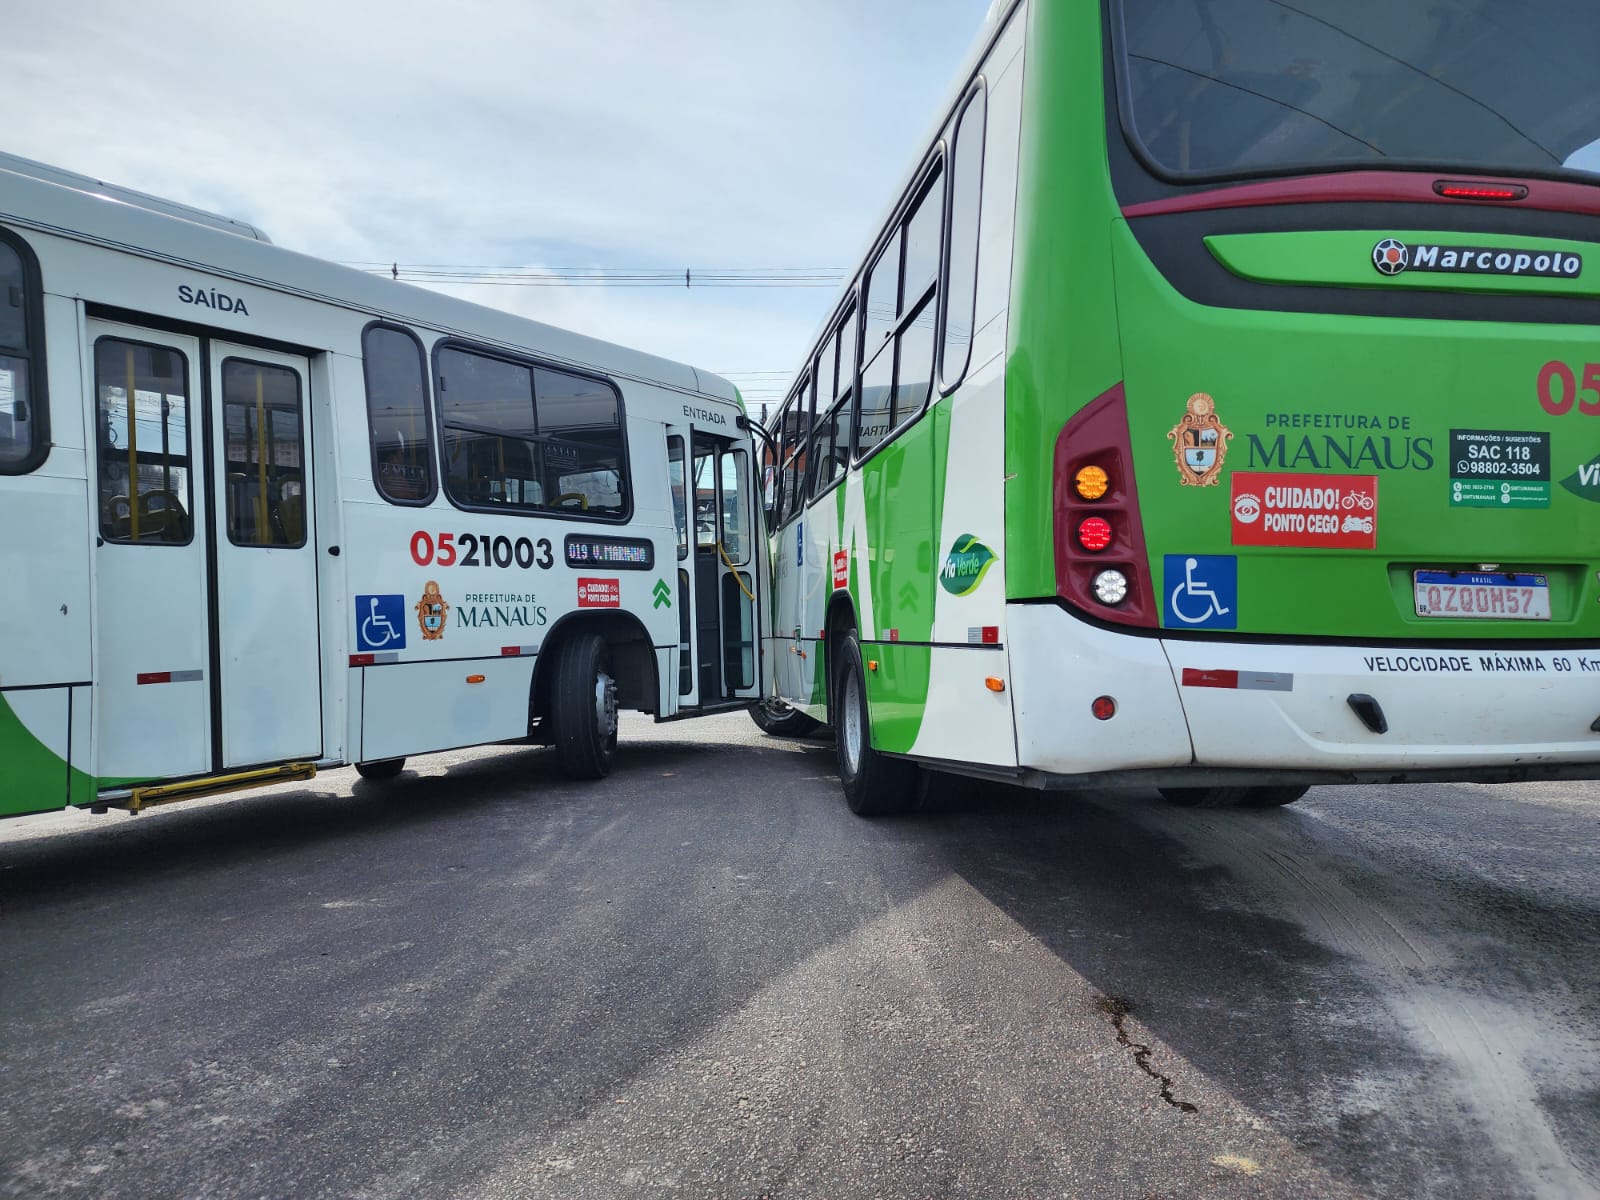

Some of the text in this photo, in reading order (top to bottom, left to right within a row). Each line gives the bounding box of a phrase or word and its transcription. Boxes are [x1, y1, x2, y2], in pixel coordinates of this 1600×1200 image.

[1413, 246, 1579, 273] Marcopolo
[178, 284, 249, 316] SAÍDA
[683, 404, 727, 425] ENTRADA
[1266, 413, 1410, 430] PREFEITURA DE
[1246, 434, 1434, 471] MANAUS
[1468, 445, 1530, 460] SAC 118
[1470, 462, 1541, 475] 98802-3504
[1265, 486, 1340, 510] CUIDADO!
[1264, 513, 1339, 533] PONTO CEGO
[410, 530, 554, 570] 0521003
[957, 552, 980, 576] Verde
[465, 593, 536, 603] PREFEITURA DE
[456, 606, 547, 628] MANAUS
[1364, 656, 1472, 672] VELOCIDADE
[1479, 652, 1546, 672] MÁXIMA
[1553, 658, 1571, 672] 60
